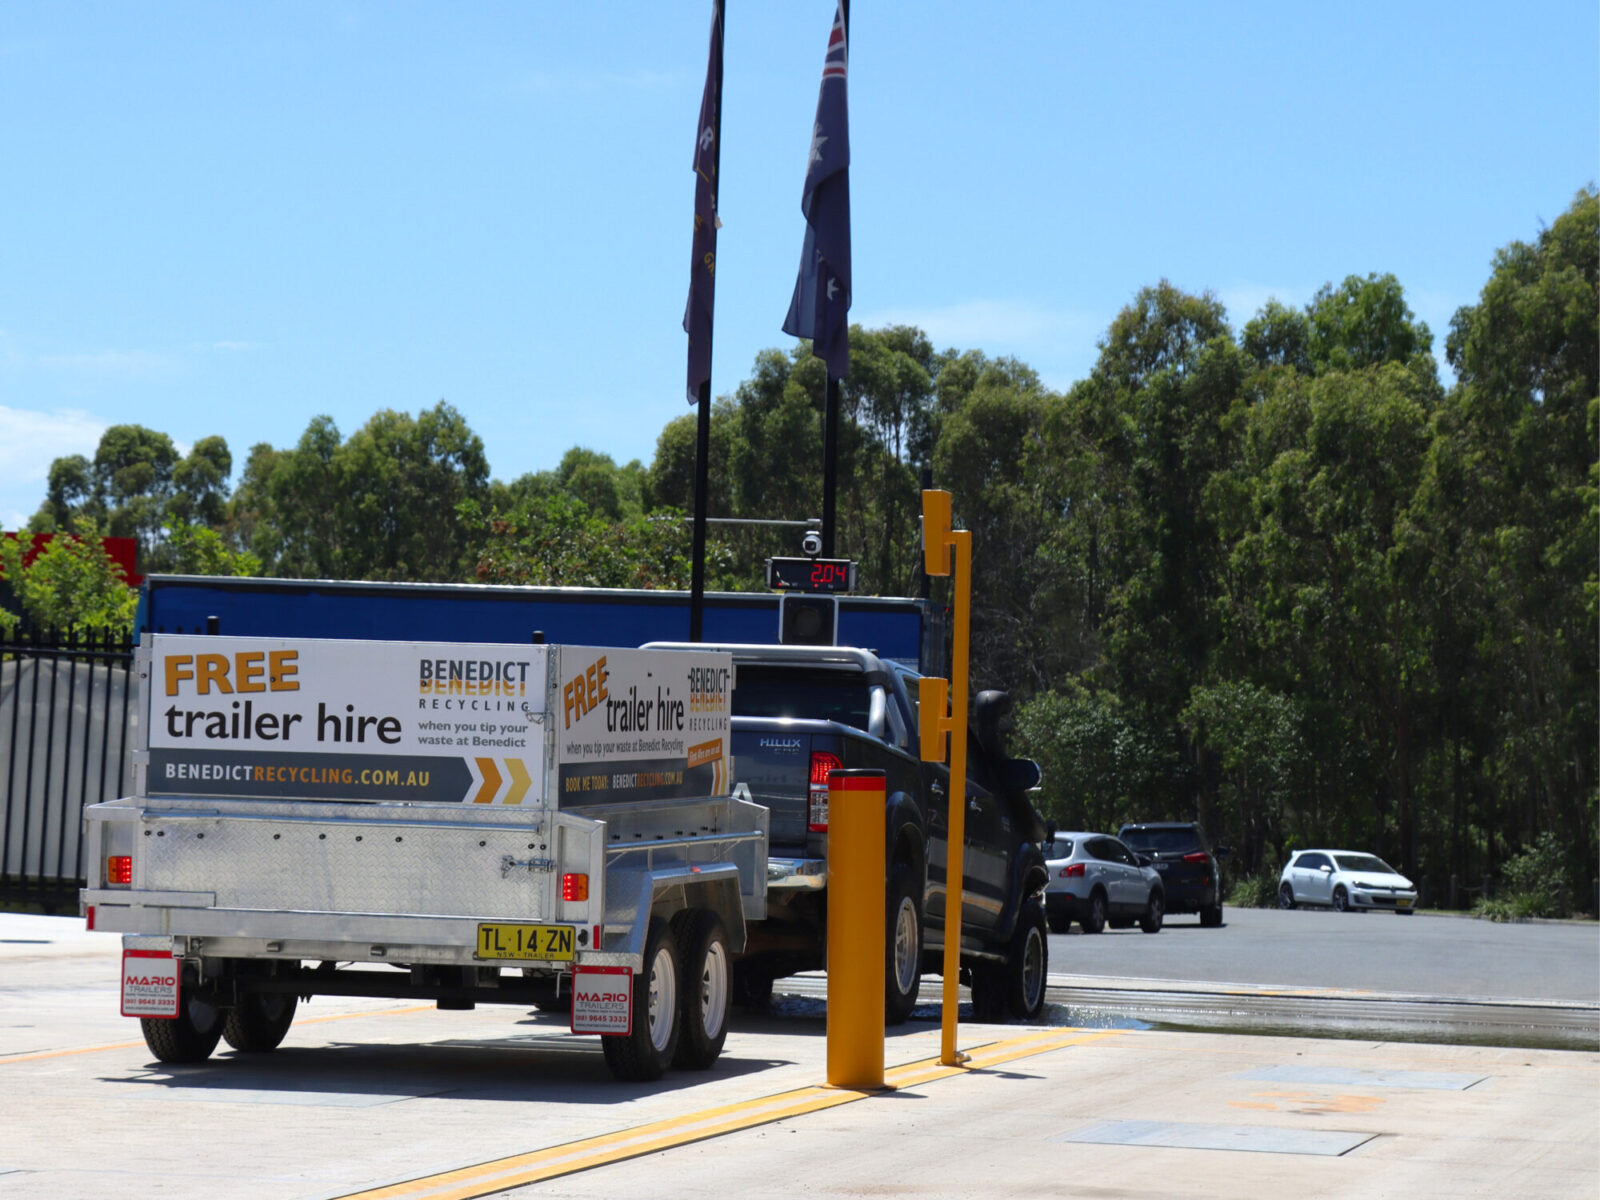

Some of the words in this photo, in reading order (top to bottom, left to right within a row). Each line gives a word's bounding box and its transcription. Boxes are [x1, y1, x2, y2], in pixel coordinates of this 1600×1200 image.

[811, 564, 847, 583] 2.04
[164, 649, 300, 697] FREE
[420, 659, 530, 682] BENEDICT
[690, 667, 728, 693] BENEDICT
[563, 655, 608, 730] FREE
[419, 698, 529, 712] RECYCLING
[606, 685, 653, 732] trailer
[657, 685, 684, 731] hire
[164, 700, 303, 741] trailer
[317, 702, 402, 744] hire
[418, 720, 451, 731] when
[454, 723, 477, 734] you
[480, 722, 497, 735] tip
[500, 724, 528, 735] your
[689, 717, 727, 731] RECYCLING
[418, 736, 454, 746] waste
[456, 736, 469, 746] at
[472, 736, 526, 747] Benedict
[566, 740, 582, 754] when
[583, 742, 593, 758] you
[594, 740, 602, 757] tip
[603, 742, 615, 757] your
[616, 740, 631, 753] waste
[632, 740, 638, 752] at
[639, 738, 661, 752] Benedict
[662, 738, 684, 755] Recycling
[760, 738, 800, 747] HILUX
[165, 763, 430, 786] BENEDICTRECYCLING.COM.AU
[126, 976, 176, 986] MARIO
[576, 992, 628, 1002] MARIO
[579, 1002, 625, 1010] TRAILERS
